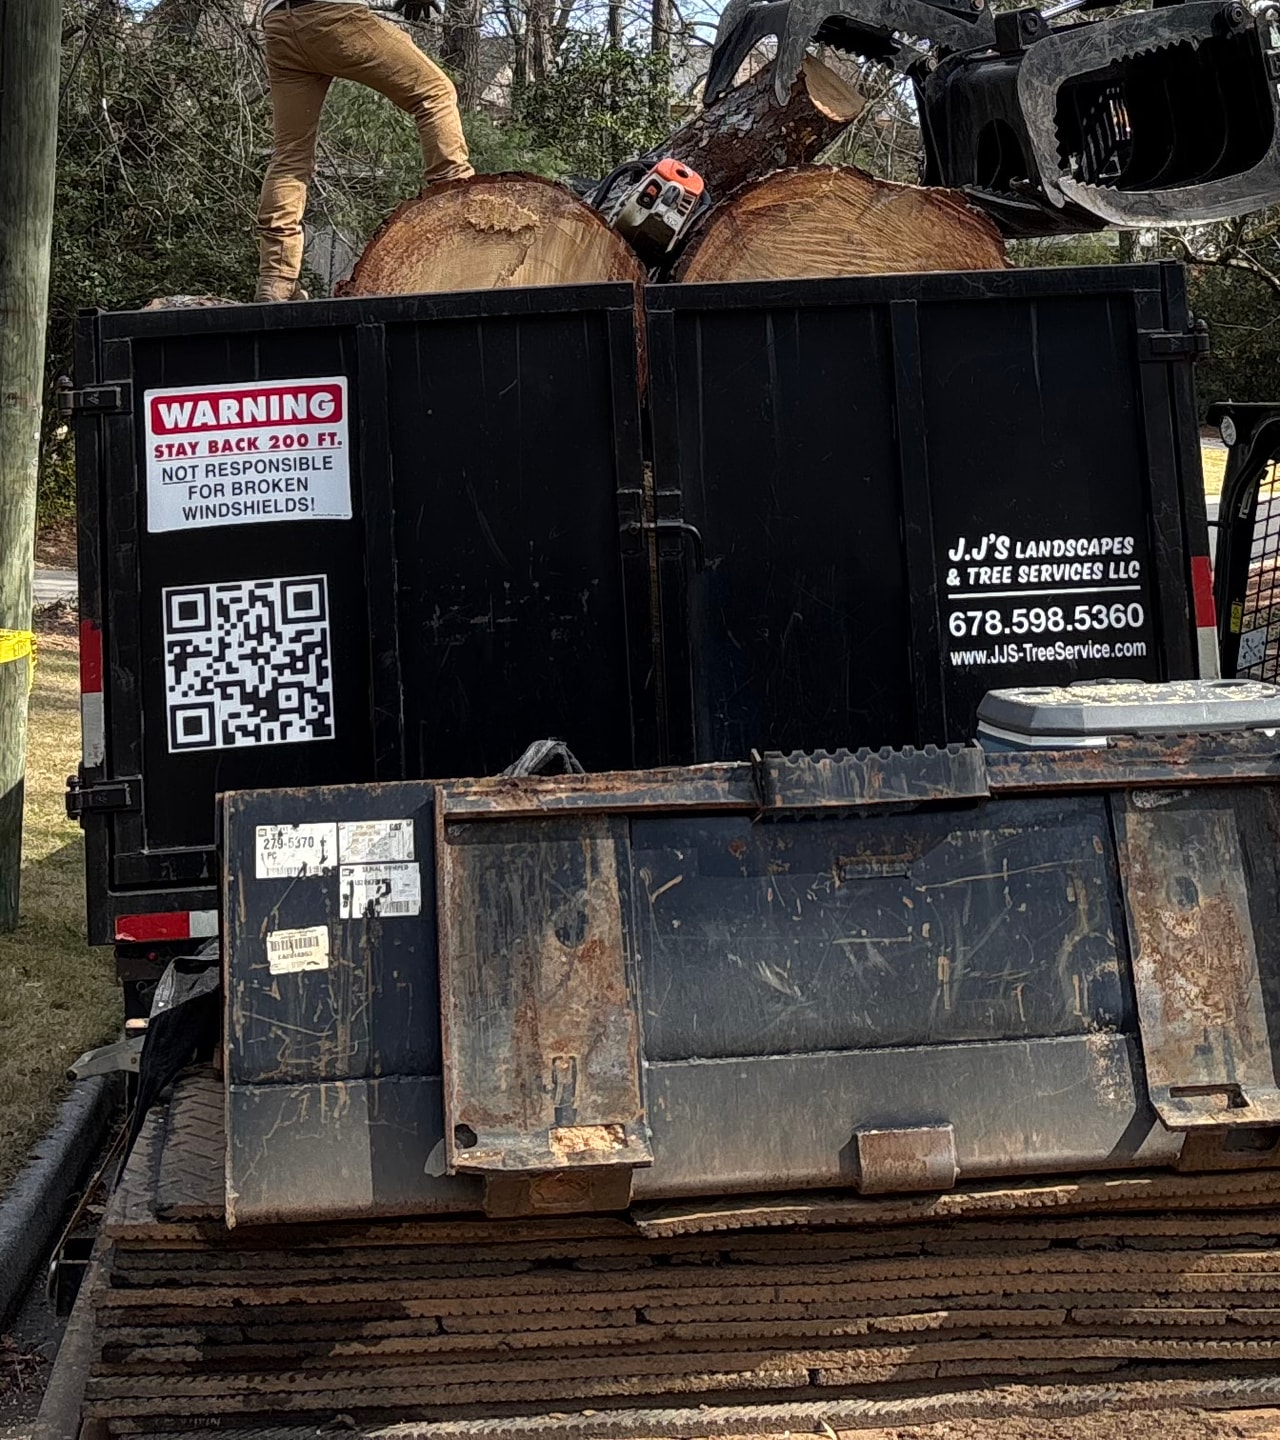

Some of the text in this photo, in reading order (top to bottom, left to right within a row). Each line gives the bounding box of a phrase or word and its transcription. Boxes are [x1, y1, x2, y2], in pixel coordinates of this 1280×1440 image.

[157, 392, 336, 429] WARNING
[154, 432, 343, 459] STAY BACK 200 FT.
[162, 455, 334, 483] NOT RESPONSIBLE
[188, 477, 309, 501] FOR BROKEN
[182, 497, 316, 522] WINDSHIELDS!
[948, 533, 1135, 562] J.J'S LANDSCAPES
[946, 560, 1141, 586] & TREE SERVICES LLC
[948, 602, 1144, 638] 678.598.5360
[950, 640, 1147, 667] www.JJS-TreeService.com
